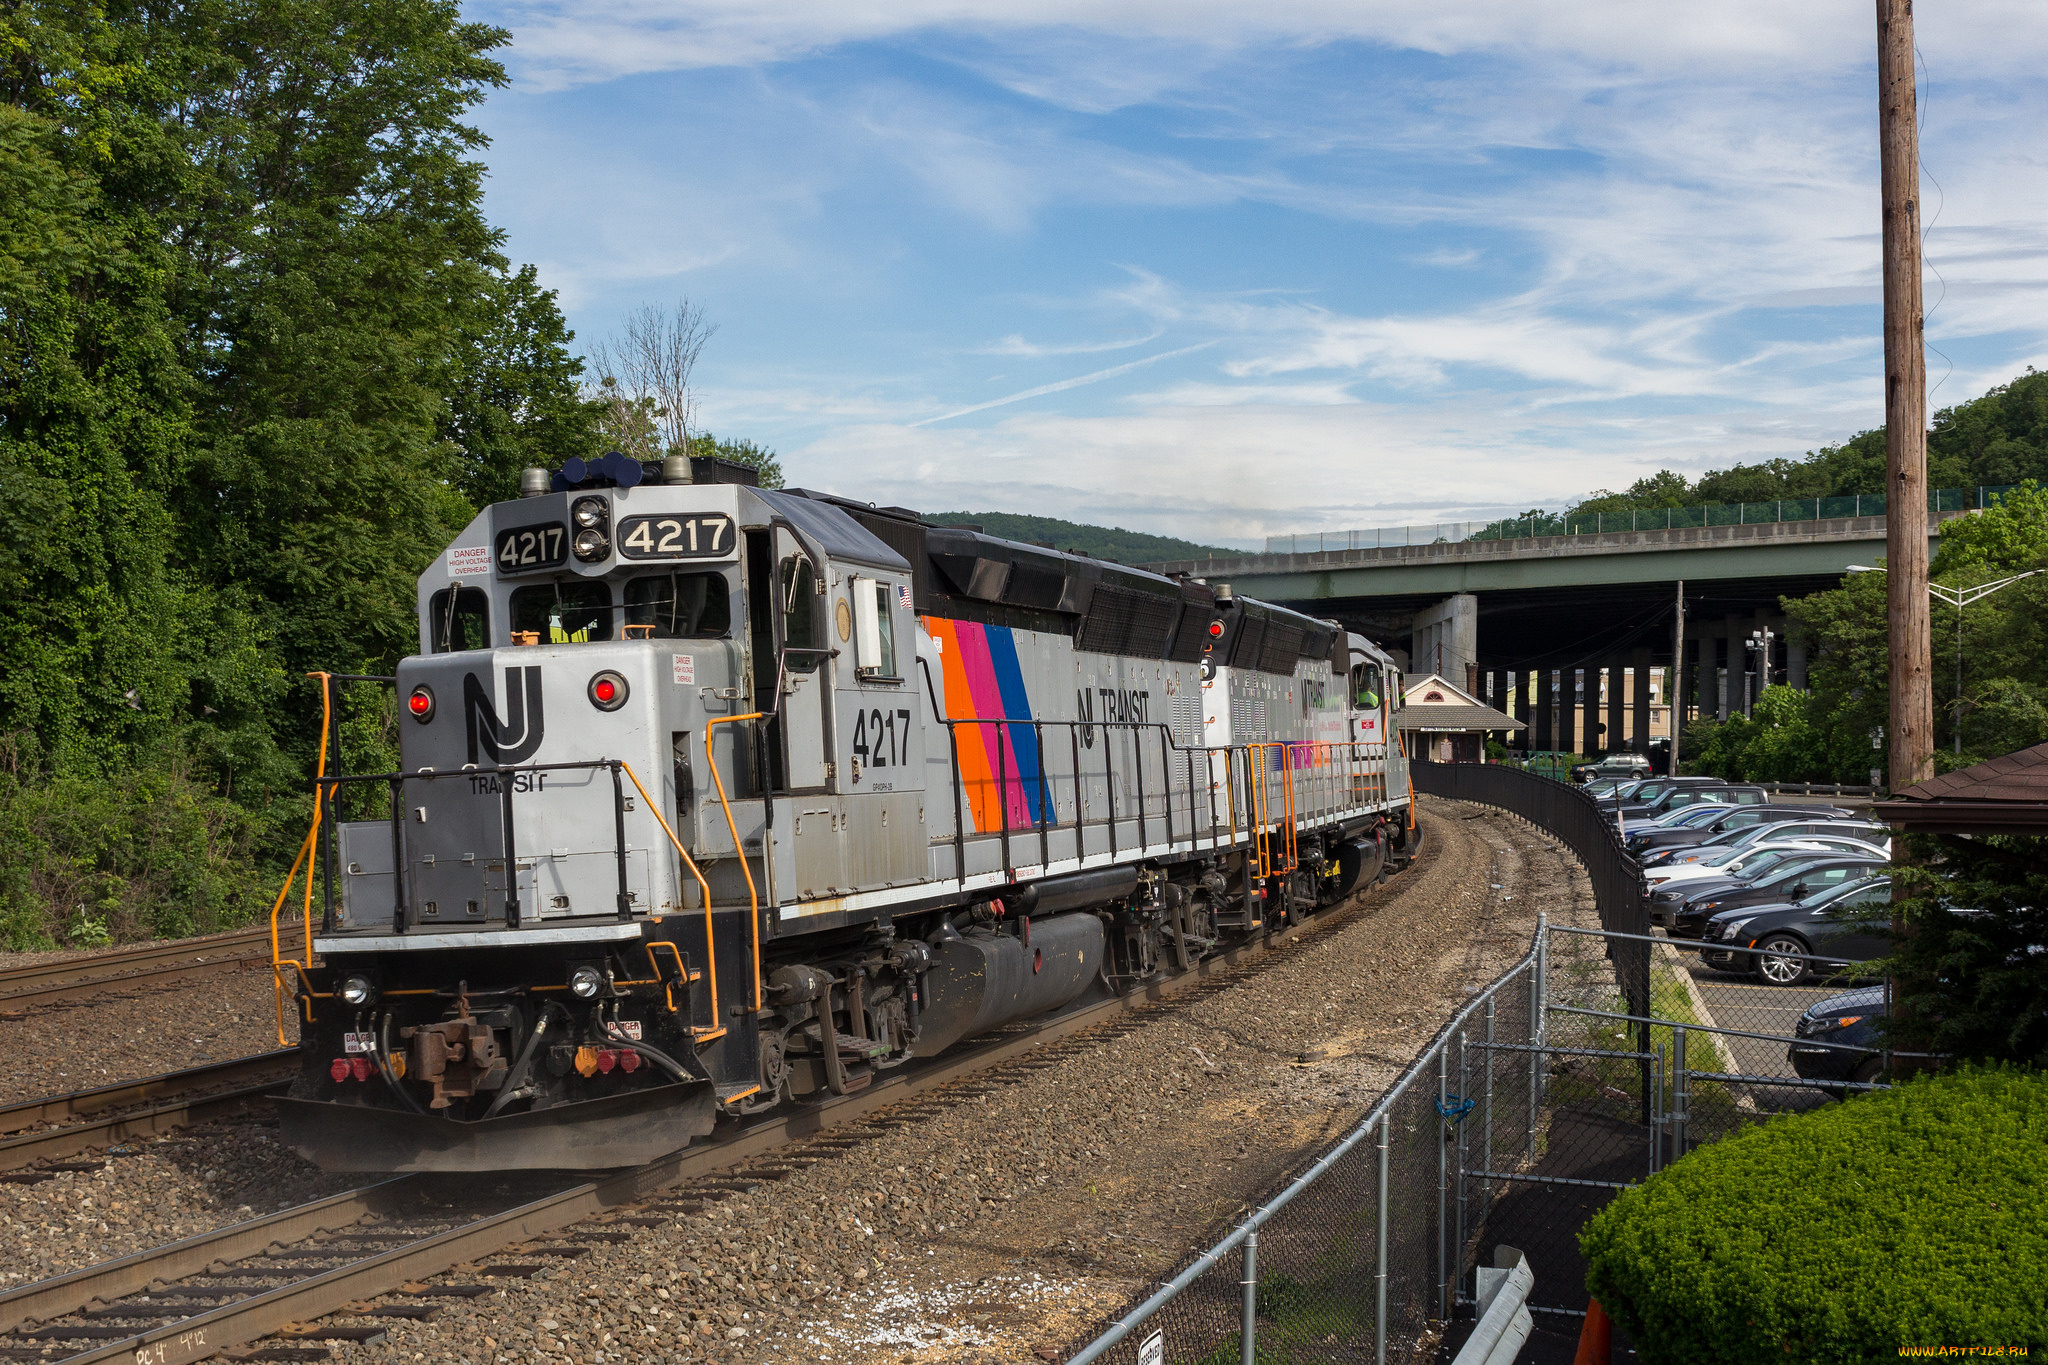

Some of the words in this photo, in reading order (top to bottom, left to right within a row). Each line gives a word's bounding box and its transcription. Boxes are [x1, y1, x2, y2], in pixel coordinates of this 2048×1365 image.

[454, 548, 486, 558] DANGER
[500, 527, 563, 566] 4217
[625, 518, 728, 553] 4217
[455, 566, 487, 574] OVERHEAD
[465, 556, 492, 565] VOLTAGE
[463, 665, 545, 766] NJ
[1077, 687, 1094, 750] NJ
[1099, 688, 1149, 730] TRANSIT
[853, 708, 910, 768] 4217
[468, 773, 548, 795] TRASIT
